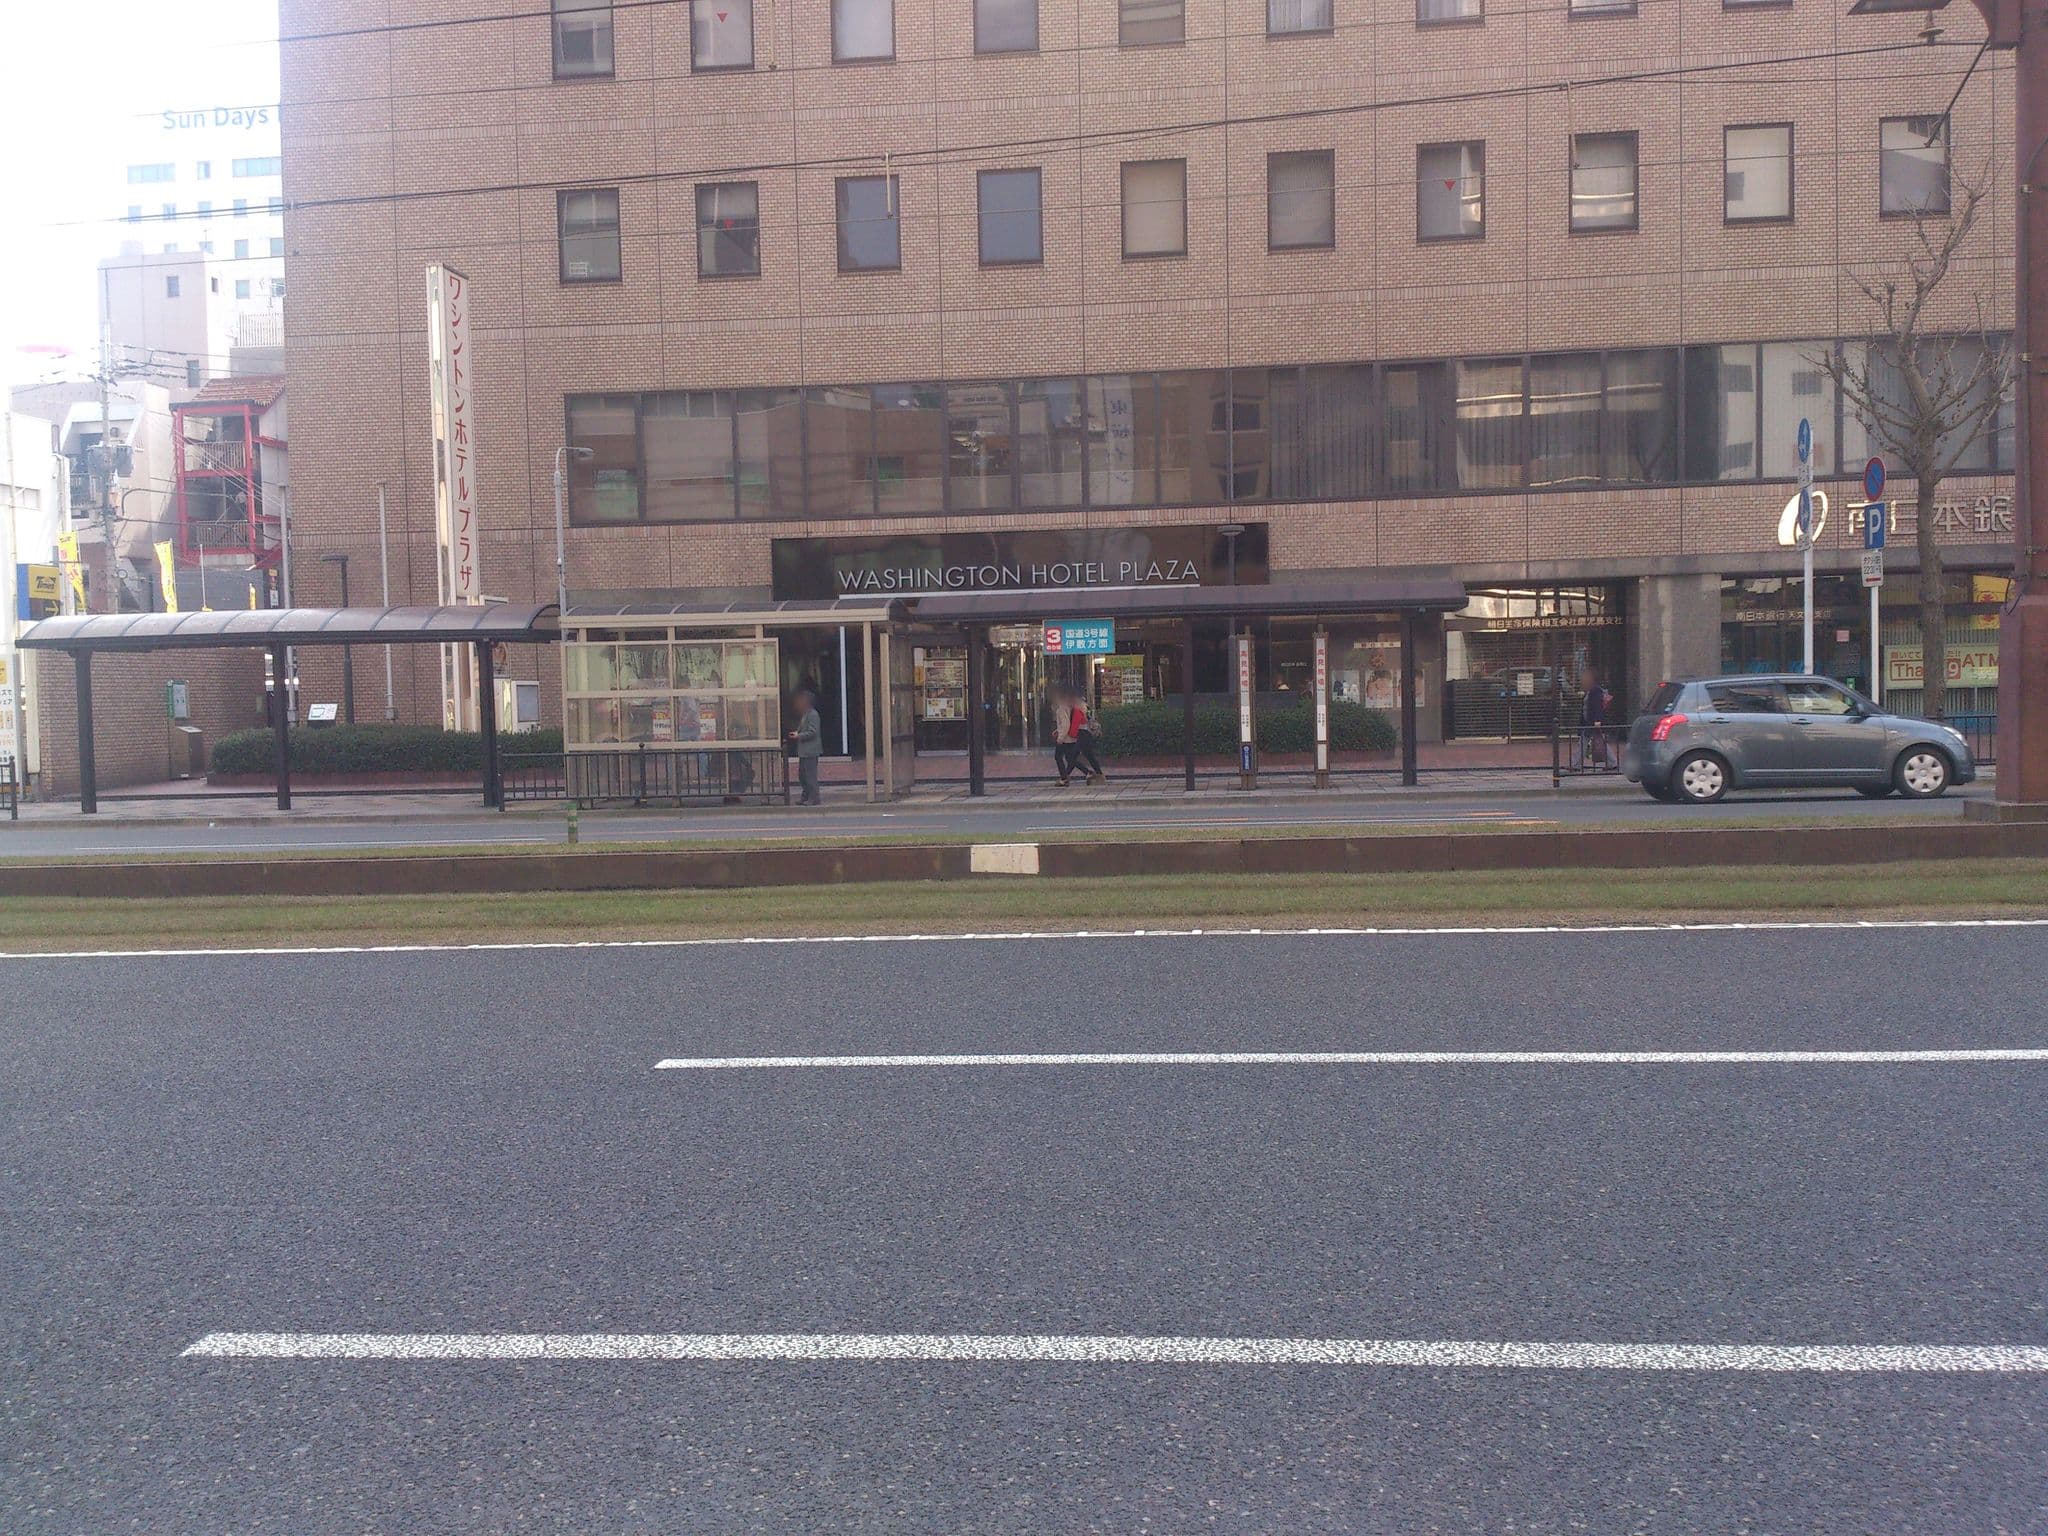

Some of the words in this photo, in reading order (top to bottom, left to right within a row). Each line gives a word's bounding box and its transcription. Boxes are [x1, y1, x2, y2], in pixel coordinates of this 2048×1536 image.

[162, 110, 205, 129] Sun
[214, 106, 269, 130] Days
[450, 275, 472, 591] ワシントンホテルプラザ
[1869, 508, 1882, 545] P
[838, 564, 1021, 590] WASHINGTON
[1032, 562, 1110, 585] HOTEL
[1119, 560, 1200, 582] PLAZA
[1788, 608, 1833, 620] 天文支店
[1047, 629, 1061, 644] 3
